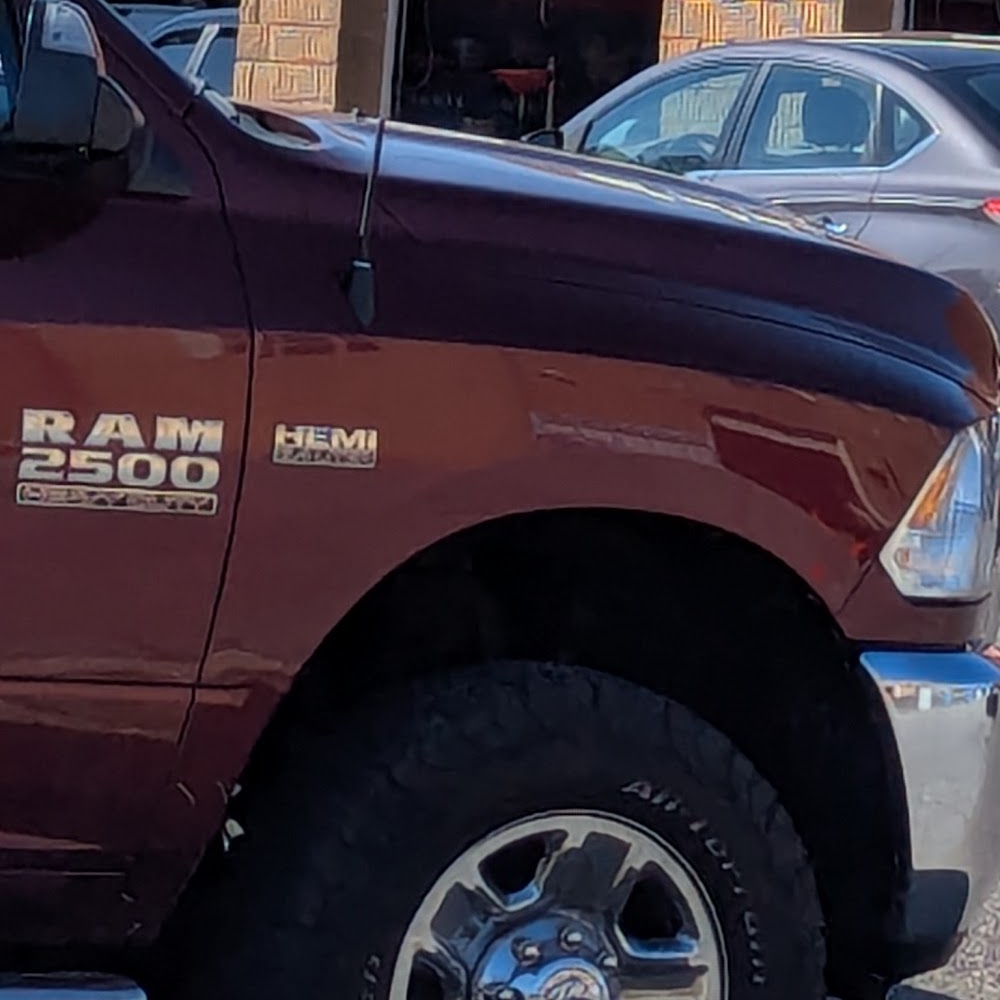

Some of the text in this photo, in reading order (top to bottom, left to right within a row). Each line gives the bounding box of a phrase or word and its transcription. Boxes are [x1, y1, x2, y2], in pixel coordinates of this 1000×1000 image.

[22, 408, 224, 452] RAM
[275, 423, 378, 450] HEMI
[18, 447, 220, 490] 2500
